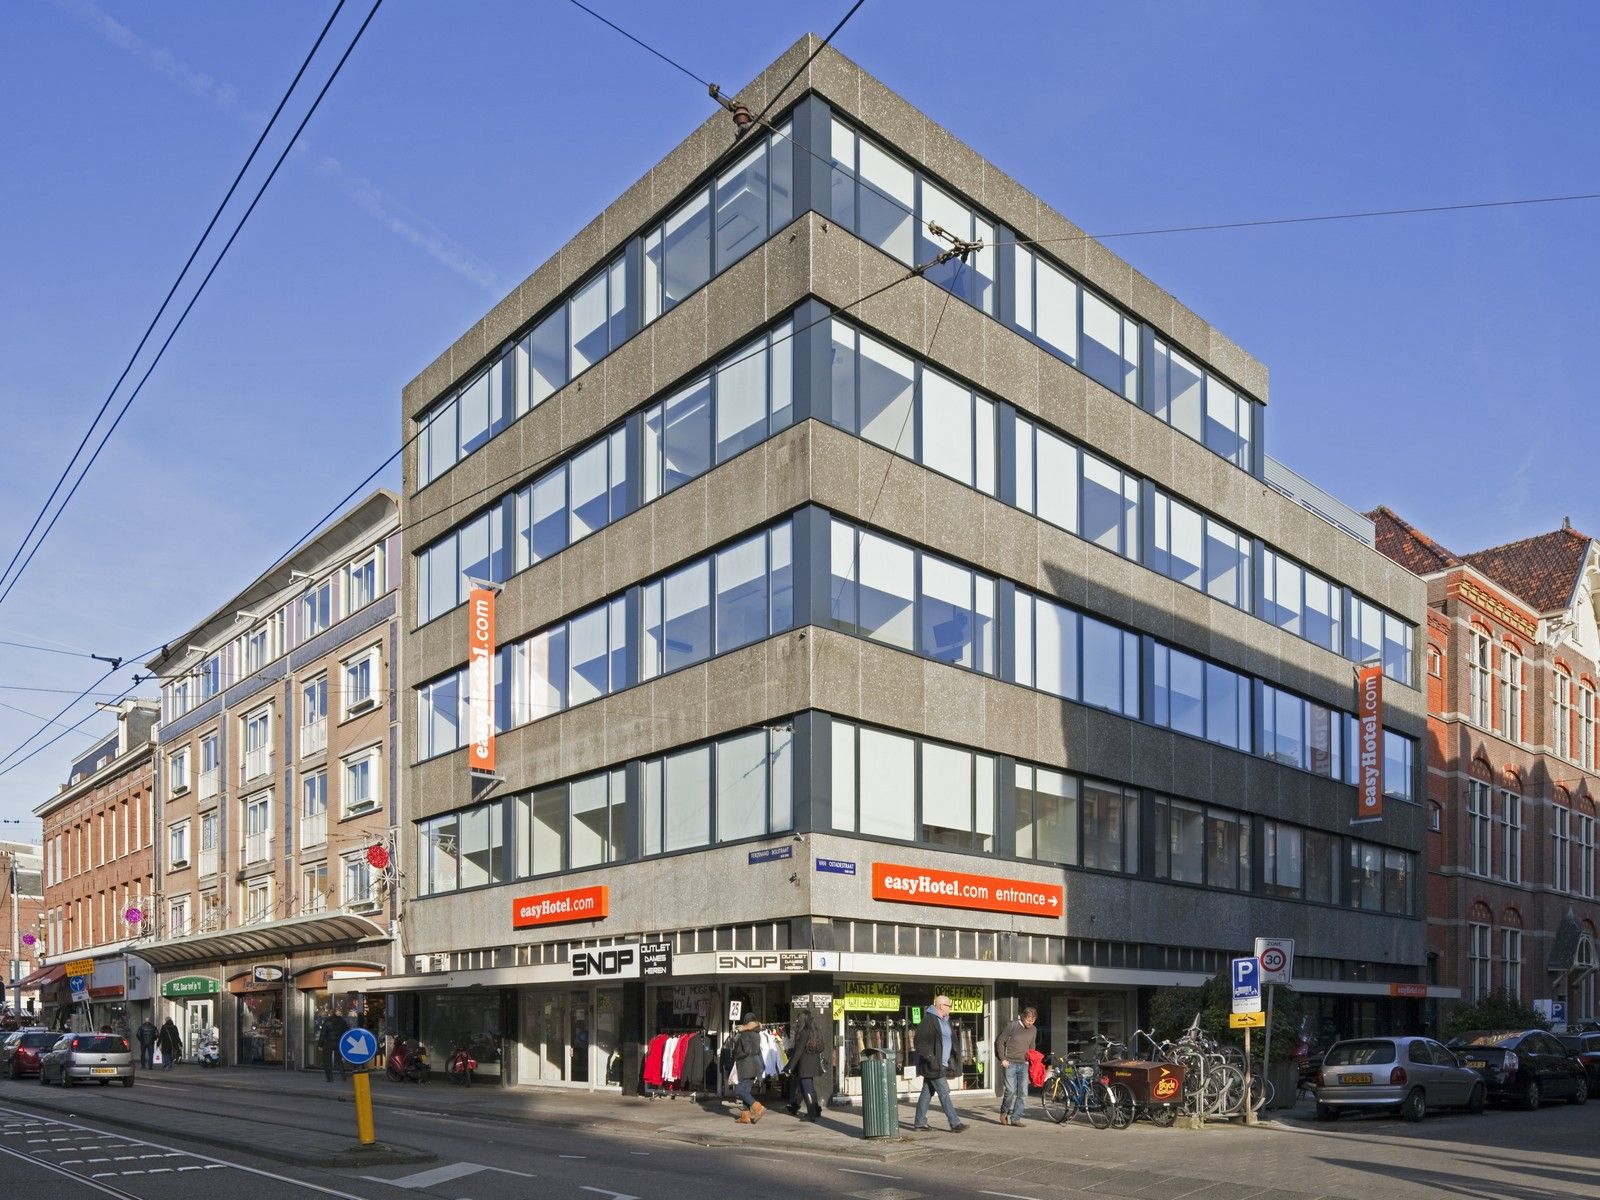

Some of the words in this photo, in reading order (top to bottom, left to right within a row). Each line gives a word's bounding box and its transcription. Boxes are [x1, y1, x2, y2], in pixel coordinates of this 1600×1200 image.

[1362, 675, 1380, 807] easyHotel.com
[884, 875, 988, 900] easyHotel.com
[995, 888, 1046, 906] entrance
[520, 897, 594, 919] easyHotel.com
[641, 943, 671, 954] OUTLET
[572, 949, 633, 977] SNOP
[644, 954, 667, 963] DAMES
[719, 956, 778, 969] SNOP
[1265, 954, 1281, 965] 30
[644, 966, 667, 975] HEREN
[1238, 961, 1253, 983] P
[845, 982, 875, 995] LAATSTE
[876, 983, 900, 995] WEKEN
[935, 986, 982, 998] OPHEFFINGS
[731, 1002, 740, 1016] 25
[1552, 1003, 1562, 1016] P
